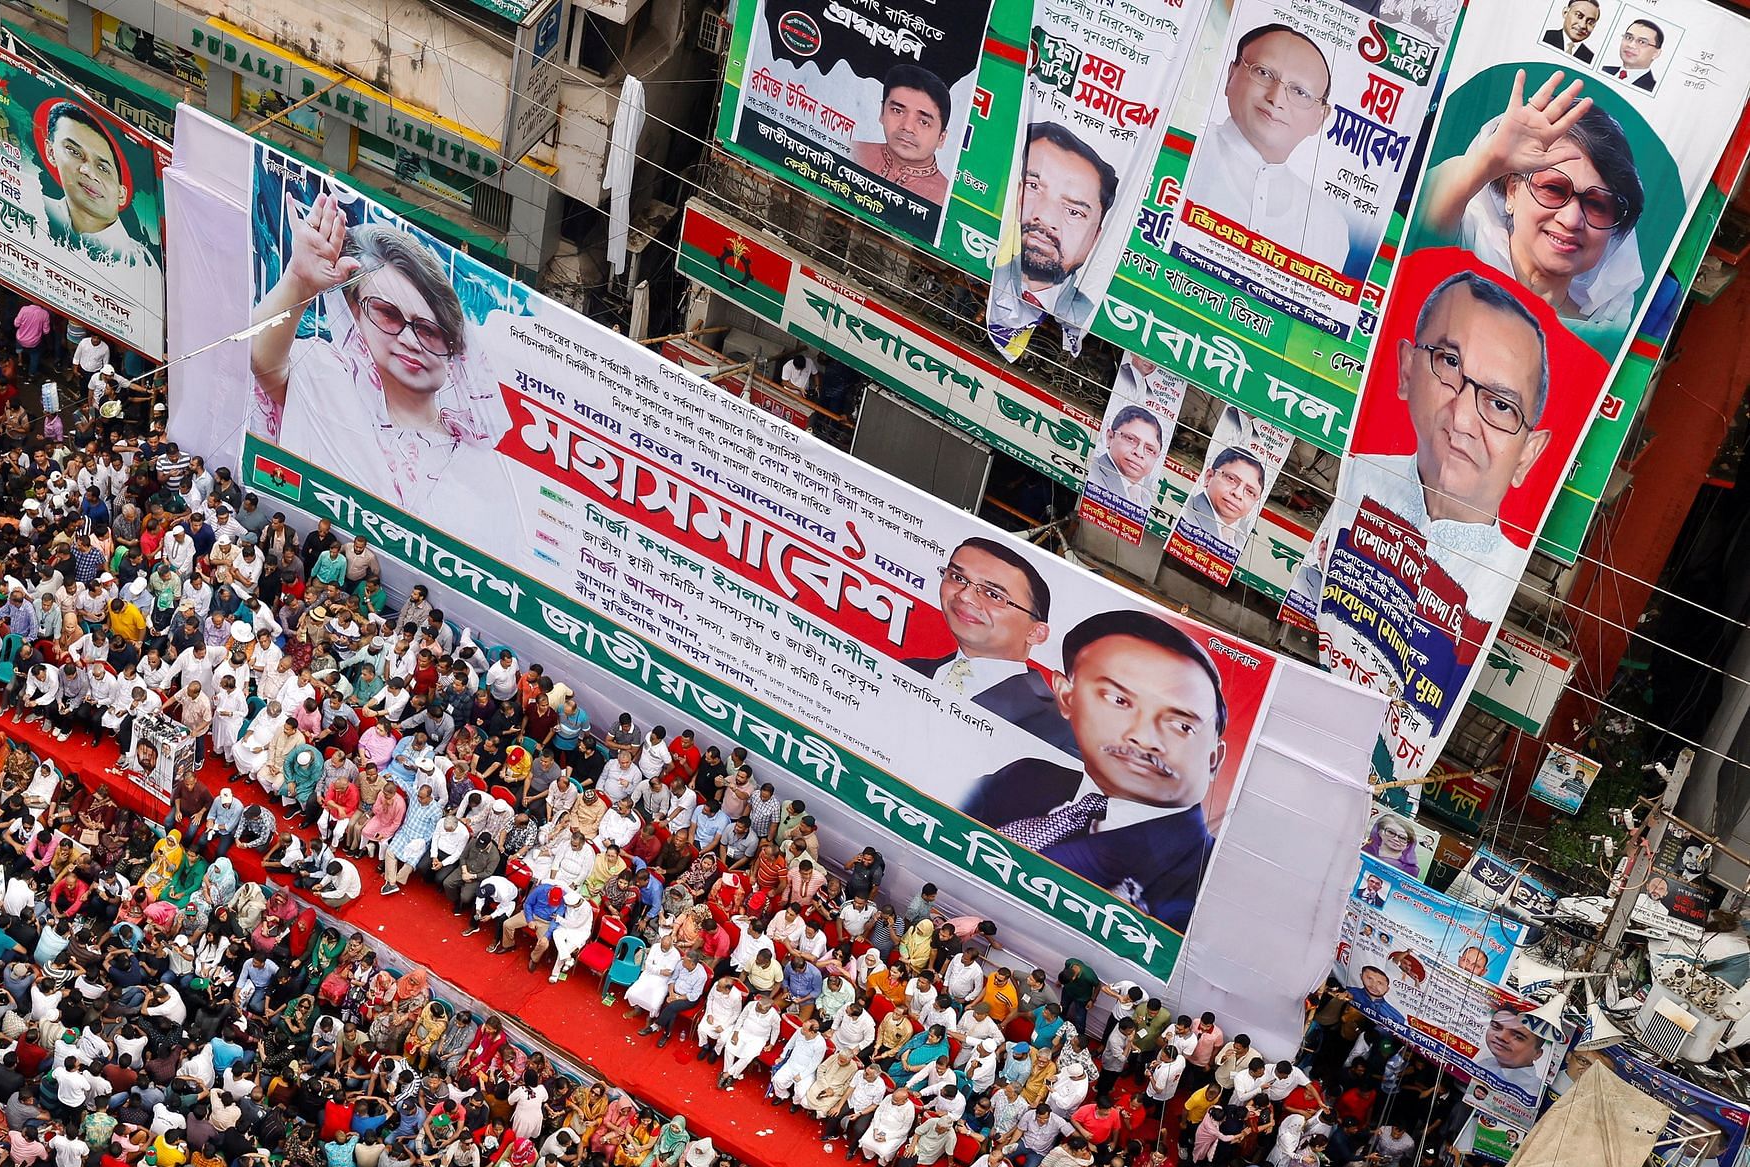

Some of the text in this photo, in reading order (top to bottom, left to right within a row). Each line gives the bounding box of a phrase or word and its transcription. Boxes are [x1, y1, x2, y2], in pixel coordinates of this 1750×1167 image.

[823, 2, 927, 61] শ্রদ্ধাঞ্জলি
[1098, 11, 1145, 42] নিরপেক্ষ
[1358, 20, 1396, 68] ১
[192, 28, 283, 85] PUBALI
[301, 77, 369, 122] BANK
[387, 116, 500, 177] LIMITED
[517, 80, 558, 130] CONSUMERS
[532, 76, 548, 99] FAIR
[752, 68, 855, 141] রমিজ উদ্দিন রাসেল
[1082, 53, 1126, 91] মহা
[1361, 73, 1404, 124] মহা
[2, 140, 21, 160] পাও
[522, 105, 548, 139] LIMITED
[1328, 105, 1410, 172] সমাবেশ
[0, 152, 20, 175] শেষ
[758, 122, 929, 220] জাতীয়তাবাদী স্বেচ্ছাসেবক দল
[784, 157, 884, 213] কেন্দ্রীয় নির্বাহী কমিটি
[1324, 181, 1379, 217] সফল করুন
[1189, 204, 1353, 302] জিএস মীর জলিল
[44, 266, 86, 297] রহমান
[91, 292, 130, 320] হামিদ
[814, 271, 865, 304] বাংলাদেশ
[1166, 269, 1272, 336] খালেদা জিয়া
[804, 290, 982, 401] বাংলাদেশ
[534, 324, 923, 528] গণতন্ত্রের ঘাতক দুর্নীতি সর্বনাশা অনাচারে লিপ্ত ফ্যাসিস্ট আওয়ামী সরকারের পদত্যাগ
[660, 364, 799, 443] বিসমিল্লাহির রাহমানির রাহিম
[510, 326, 945, 557] নির্বাচনকালীন নির্দলীয় নিরপেক্ষ সরকারের দাবি এবং দেশনেত্রী বেগম খালেদা জিয়া সহ সকল রাজবন্দীর
[612, 396, 832, 515] নিঃশর্ত মুক্তি সকল মিথ্যা মামলা প্রত্যাহারের দাবিতে
[516, 370, 925, 589] যুগপৎ ধারায় বৃহত্তর গণ-আন্দোলনের ১ দফার
[522, 402, 911, 642] মহাসমাবেশ
[1353, 524, 1401, 568] দেশনেত্রী
[1333, 549, 1374, 574] বাংলাদেশ
[575, 581, 757, 691] বীর মুক্তিযোদ্ধা আবদুস সালাম,
[577, 570, 701, 646] আমান উল্লাহ আমান,
[580, 548, 860, 710] মির্জা আব্বাস, সদস্য, জাতীয় স্থায়ী কমিটি বিএনপি
[582, 530, 880, 696] জাতীয় স্থায়ী কমিটির সদস্যবৃন্দ জাতীয় নেতৃবৃন্দ
[585, 504, 993, 736] মির্জা ফখরুল ইসলাম আলমগীর, মহাসচিব, বিএনপি
[1208, 637, 1260, 670] জিন্দাবাদ
[1320, 583, 1444, 709] আবদুল মুন্না
[1504, 633, 1552, 663] জিন্দাবাদ
[310, 480, 1161, 962] বাংলাদেশ জাতীয়তাবাদী দল-বিএনপি
